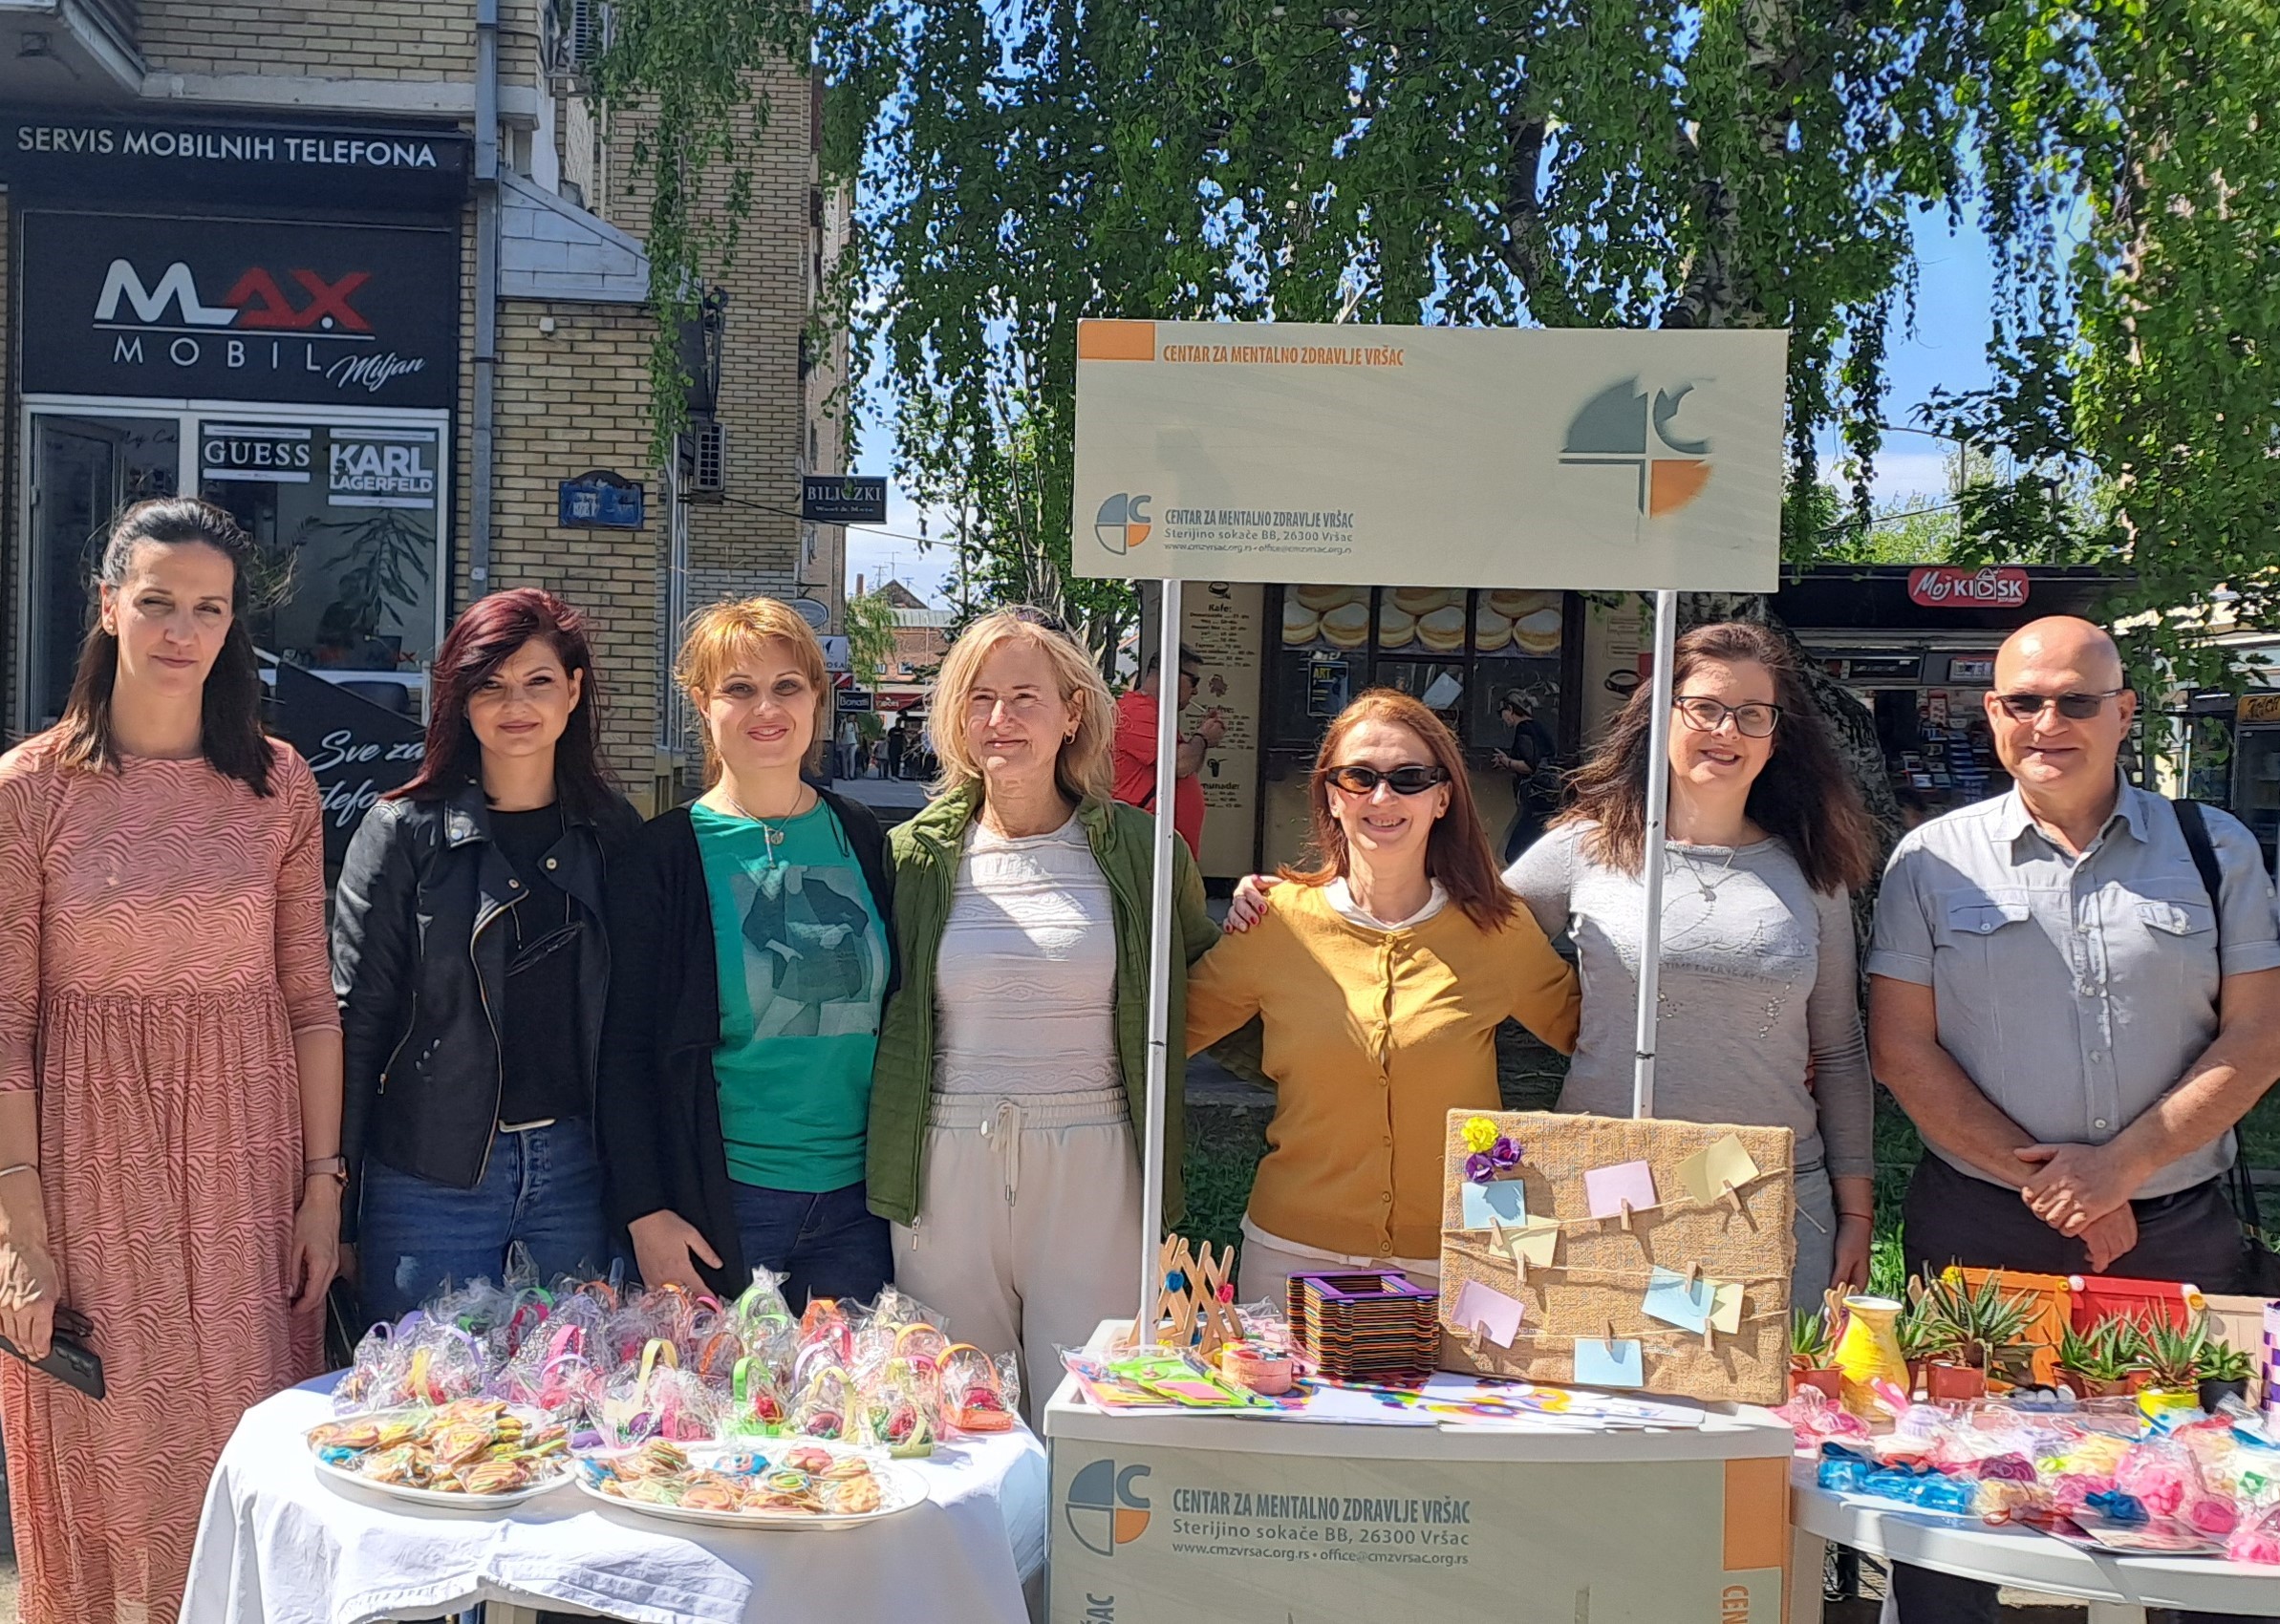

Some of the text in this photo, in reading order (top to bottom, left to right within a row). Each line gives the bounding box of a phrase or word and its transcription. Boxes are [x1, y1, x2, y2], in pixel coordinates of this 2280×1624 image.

[17, 126, 438, 168] SERVIS MOBILNIH TELEFONA
[113, 334, 321, 372] MOBIL
[1163, 344, 1405, 366] CENTAR ZA MENTALNO ZDRAVLJE VRŠAC
[325, 352, 427, 393] Miljan
[204, 440, 311, 467] GUESS
[330, 443, 433, 478] KARL
[330, 475, 433, 493] LAGERFELD
[1165, 508, 1354, 528] CENTAR ZA MENTALNO ZDRAVLJE VRŠAC
[1164, 527, 1353, 543] Sterijino sokače BB, 26300 Vršac
[1913, 571, 1952, 601] Moj
[1312, 668, 1331, 680] ART
[306, 729, 426, 773] Sve za
[319, 779, 379, 828] lefo
[1173, 1488, 1471, 1525] CENTAR ZA MENTALNO ZDRAVLJE VRŠAC
[1172, 1519, 1470, 1546] Sterijino sokače BB, 26300 Vršac
[1172, 1543, 1469, 1568] www.cmzvrsac.org.rs office@cmzvrsac.org.rs
